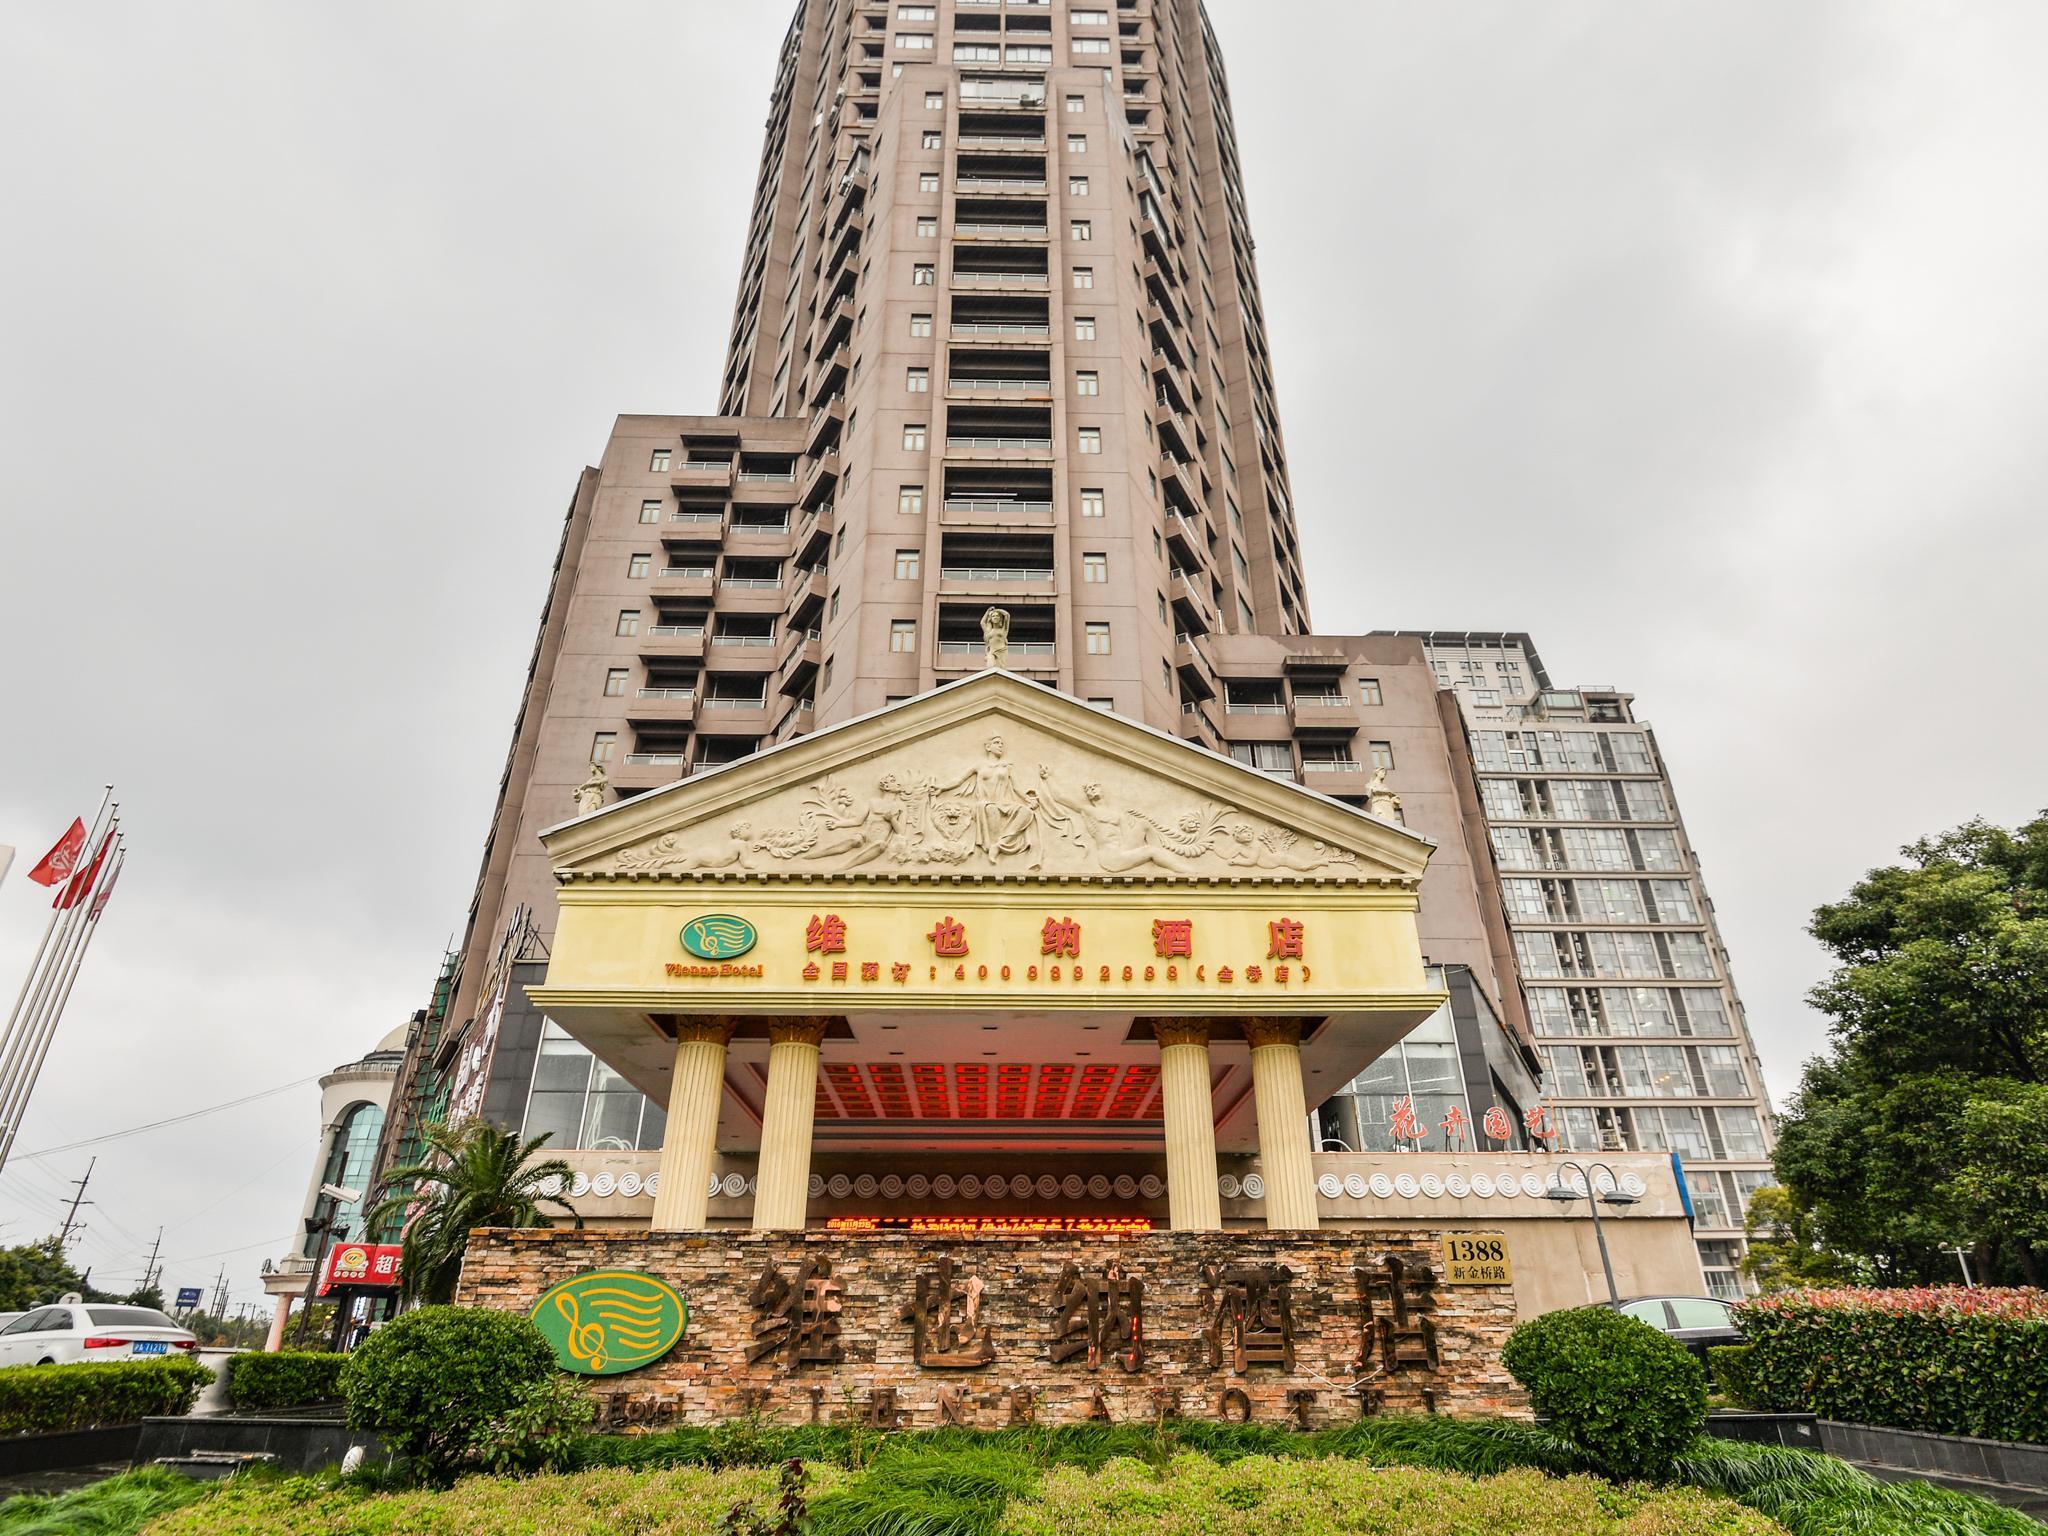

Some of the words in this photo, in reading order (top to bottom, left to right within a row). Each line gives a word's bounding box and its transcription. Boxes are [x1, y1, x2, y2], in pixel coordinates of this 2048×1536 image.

[804, 913, 1305, 960] 维也纳酒店
[664, 962, 718, 978] Vienna
[720, 963, 764, 978] Hotel
[1447, 1240, 1504, 1262] 1388
[1454, 1265, 1506, 1280] 新金桥路
[743, 1253, 1441, 1372] 维也纳酒店
